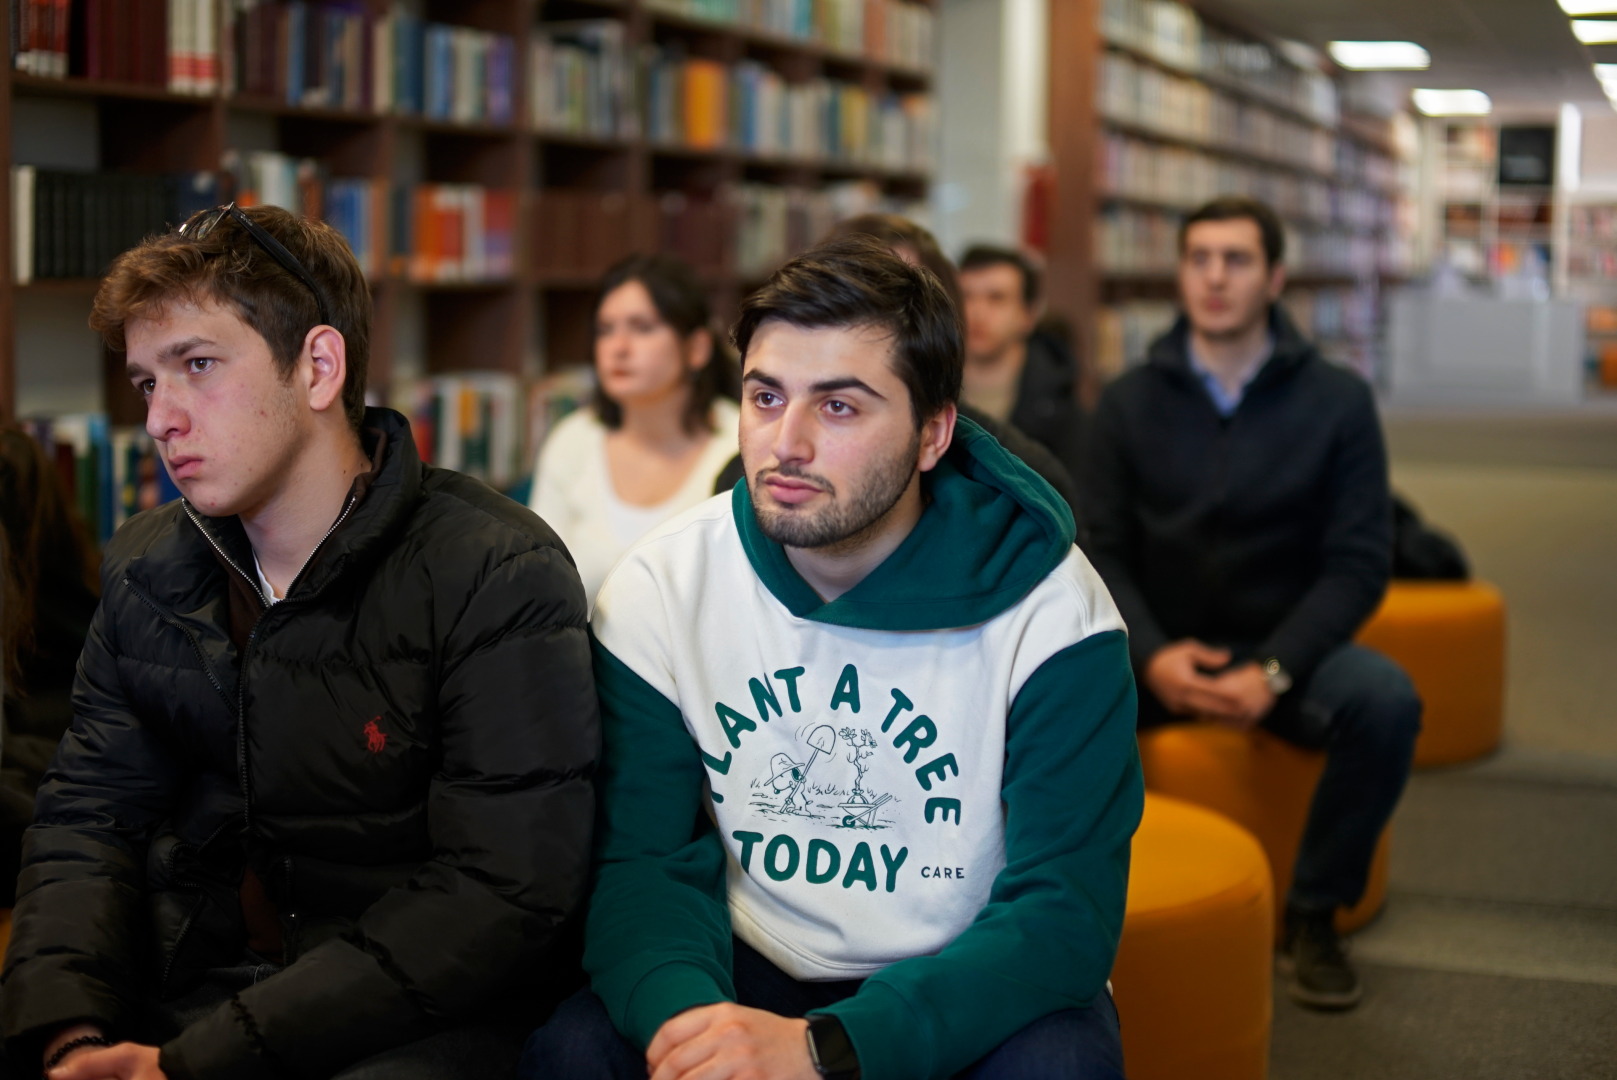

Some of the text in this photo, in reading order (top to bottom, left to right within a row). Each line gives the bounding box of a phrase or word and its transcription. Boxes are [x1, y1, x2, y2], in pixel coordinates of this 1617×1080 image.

[702, 664, 961, 826] LANT A TREE
[732, 830, 908, 892] TODAY
[921, 866, 965, 879] CARE
